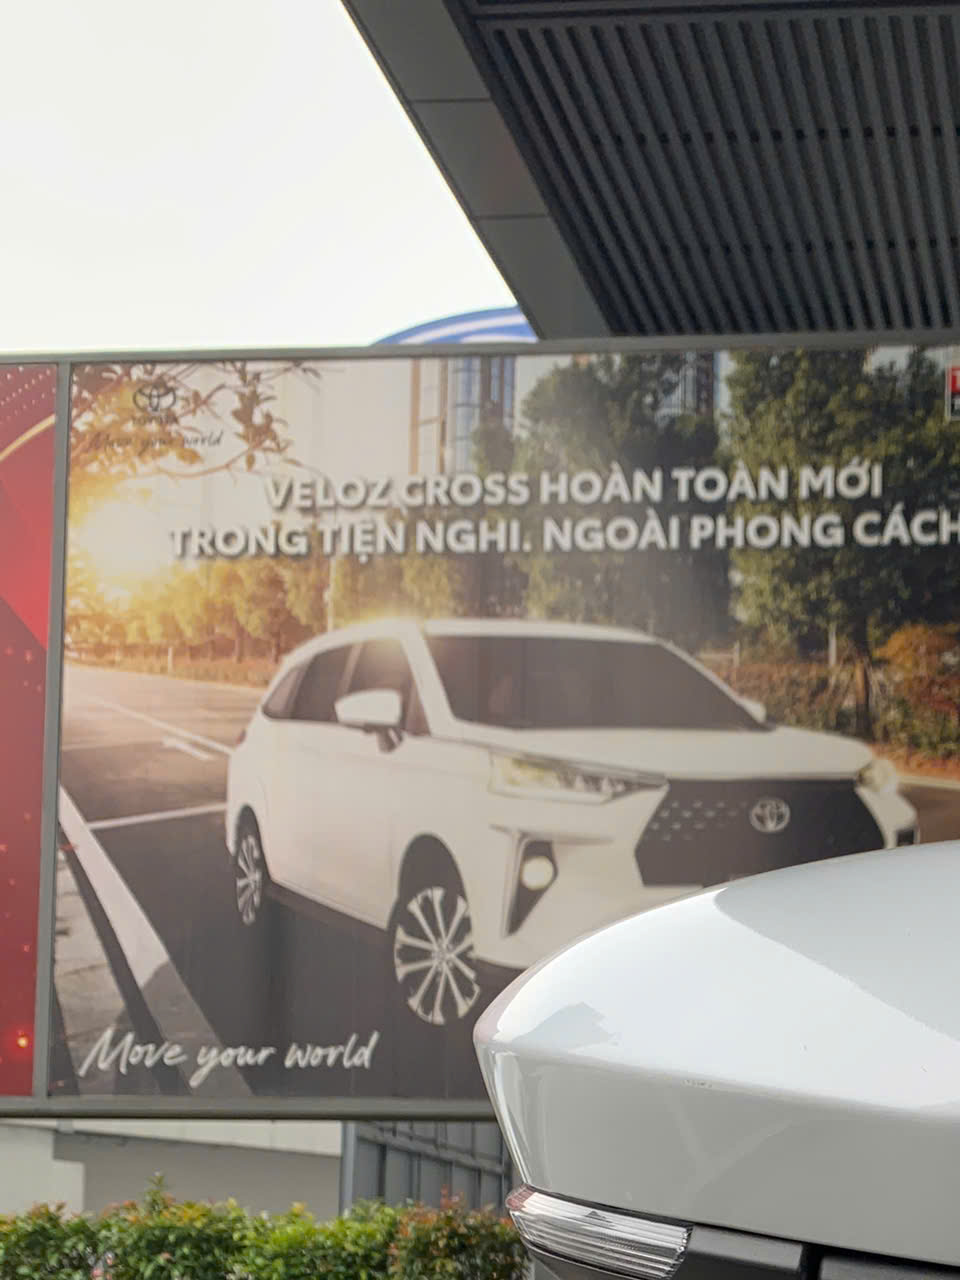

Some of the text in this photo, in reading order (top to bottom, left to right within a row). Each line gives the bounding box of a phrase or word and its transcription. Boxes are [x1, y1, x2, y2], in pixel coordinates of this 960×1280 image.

[267, 456, 883, 509] VELOZ CROSS HOÀN TOÀN MỚI
[171, 526, 308, 559] TRONG
[319, 514, 405, 564] TIỆN
[416, 520, 531, 554] NGHI.
[543, 508, 678, 551] NGOÀI
[690, 510, 845, 550] PHONG
[78, 1024, 380, 1088] Move your world
